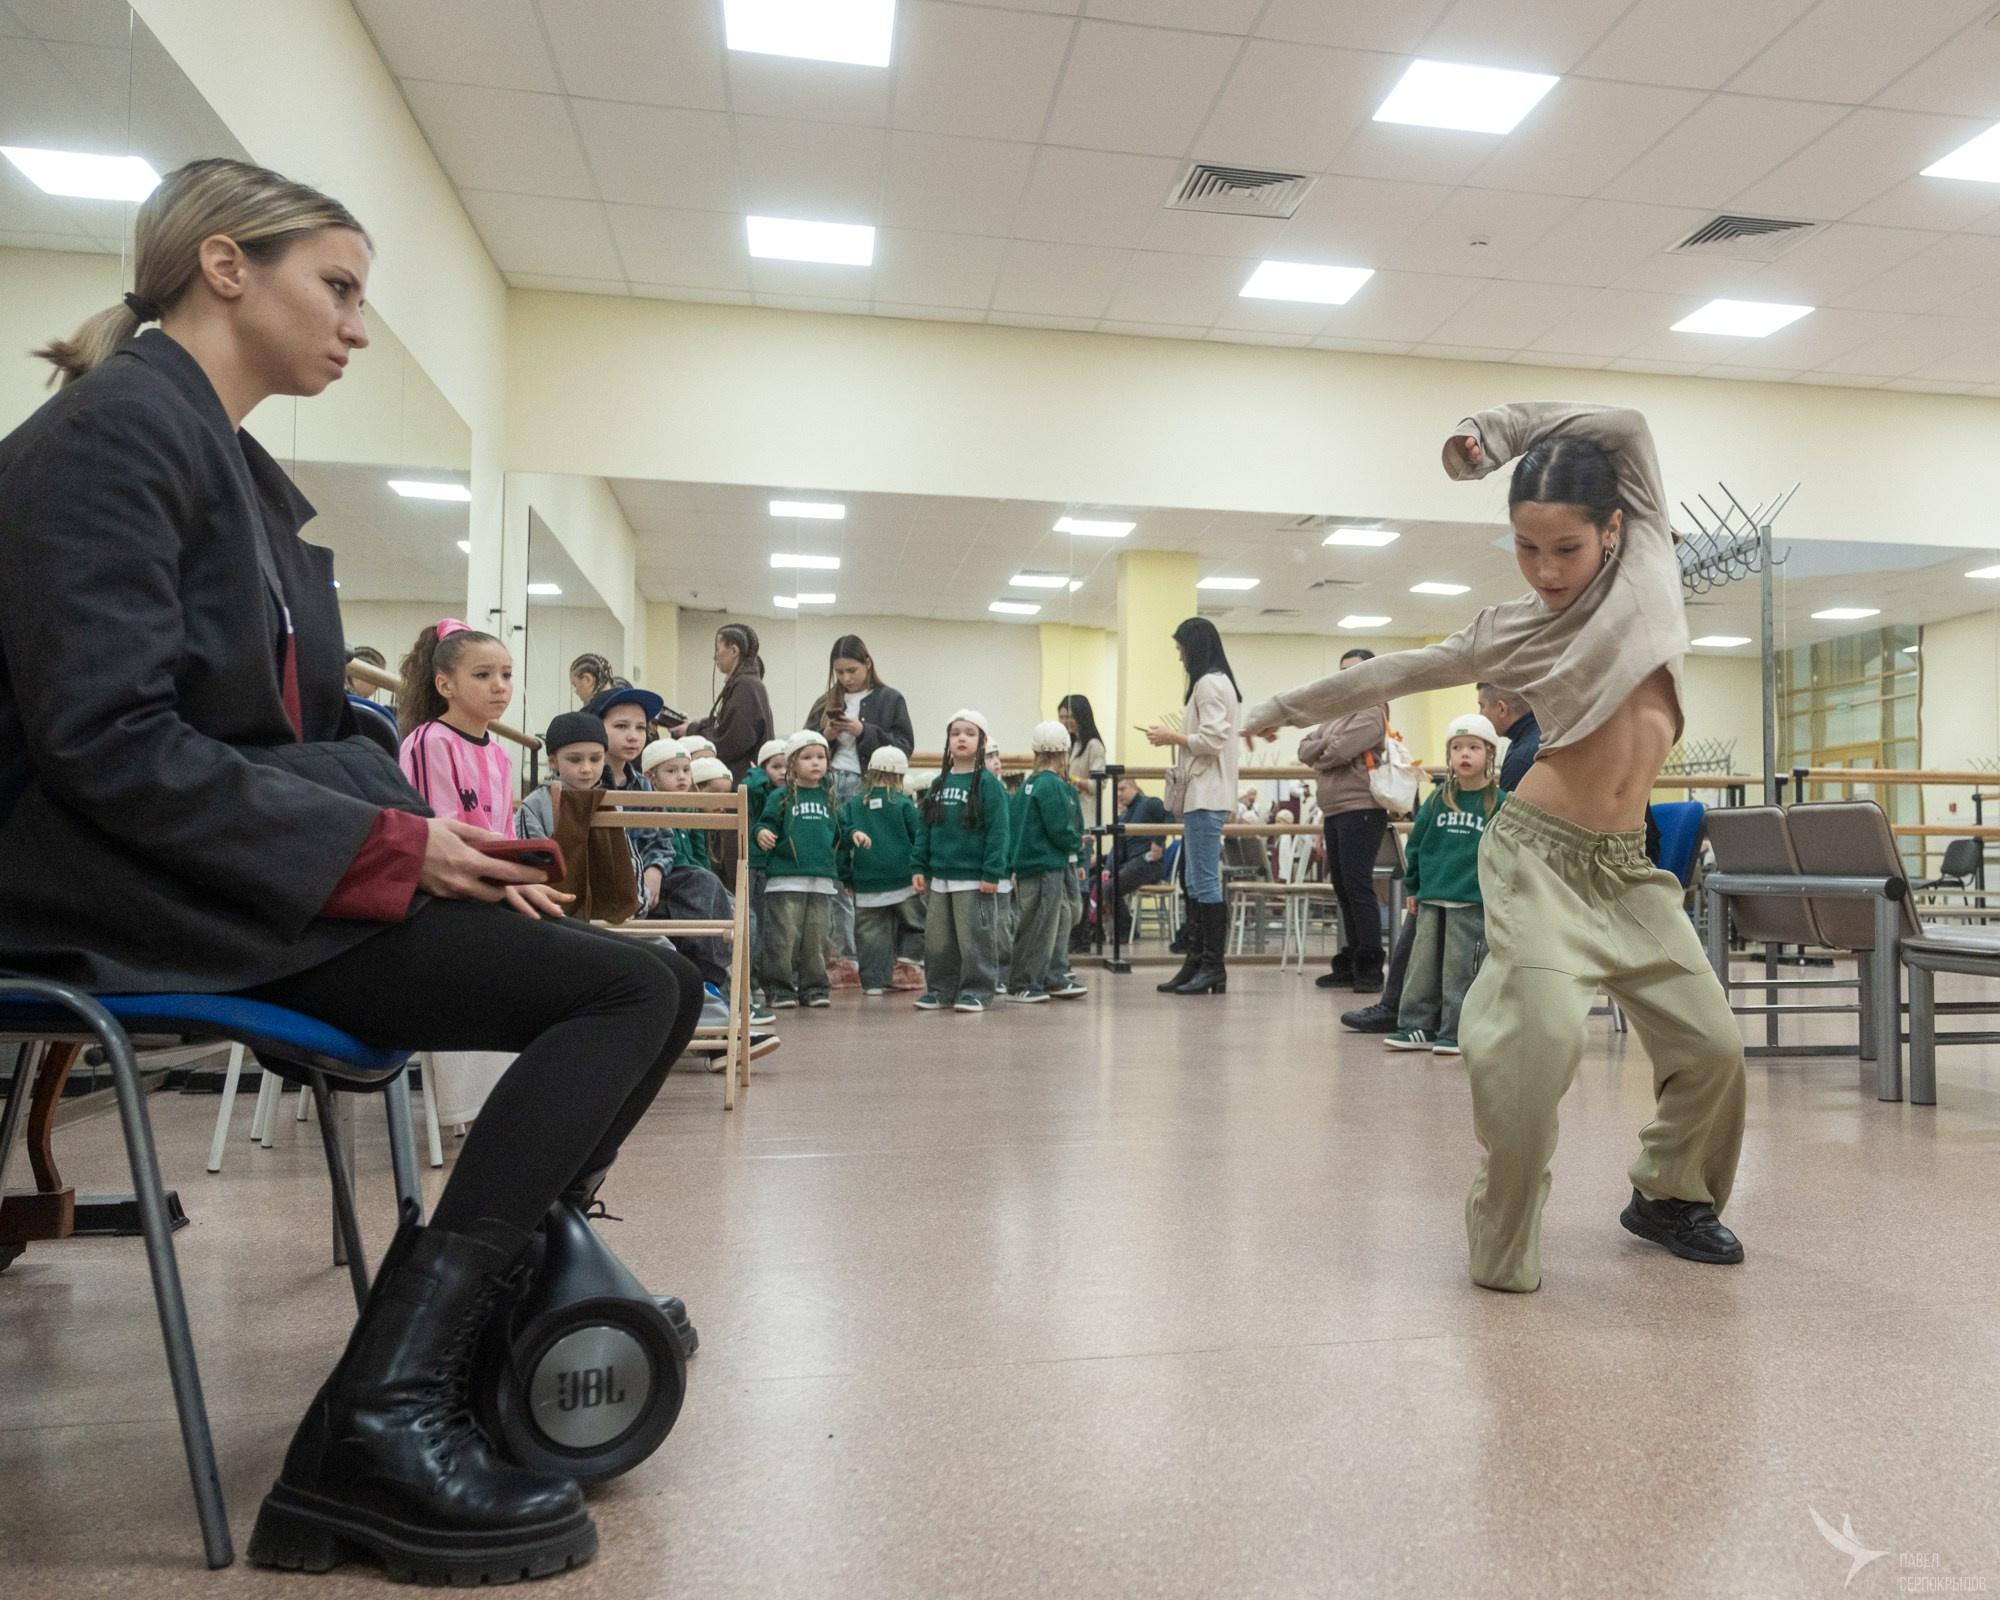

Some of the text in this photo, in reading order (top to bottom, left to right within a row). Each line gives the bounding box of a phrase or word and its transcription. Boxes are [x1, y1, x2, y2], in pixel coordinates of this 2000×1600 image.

[792, 802, 829, 818] CHILL
[1437, 811, 1484, 832] CHILL
[557, 1365, 626, 1412] JBL
